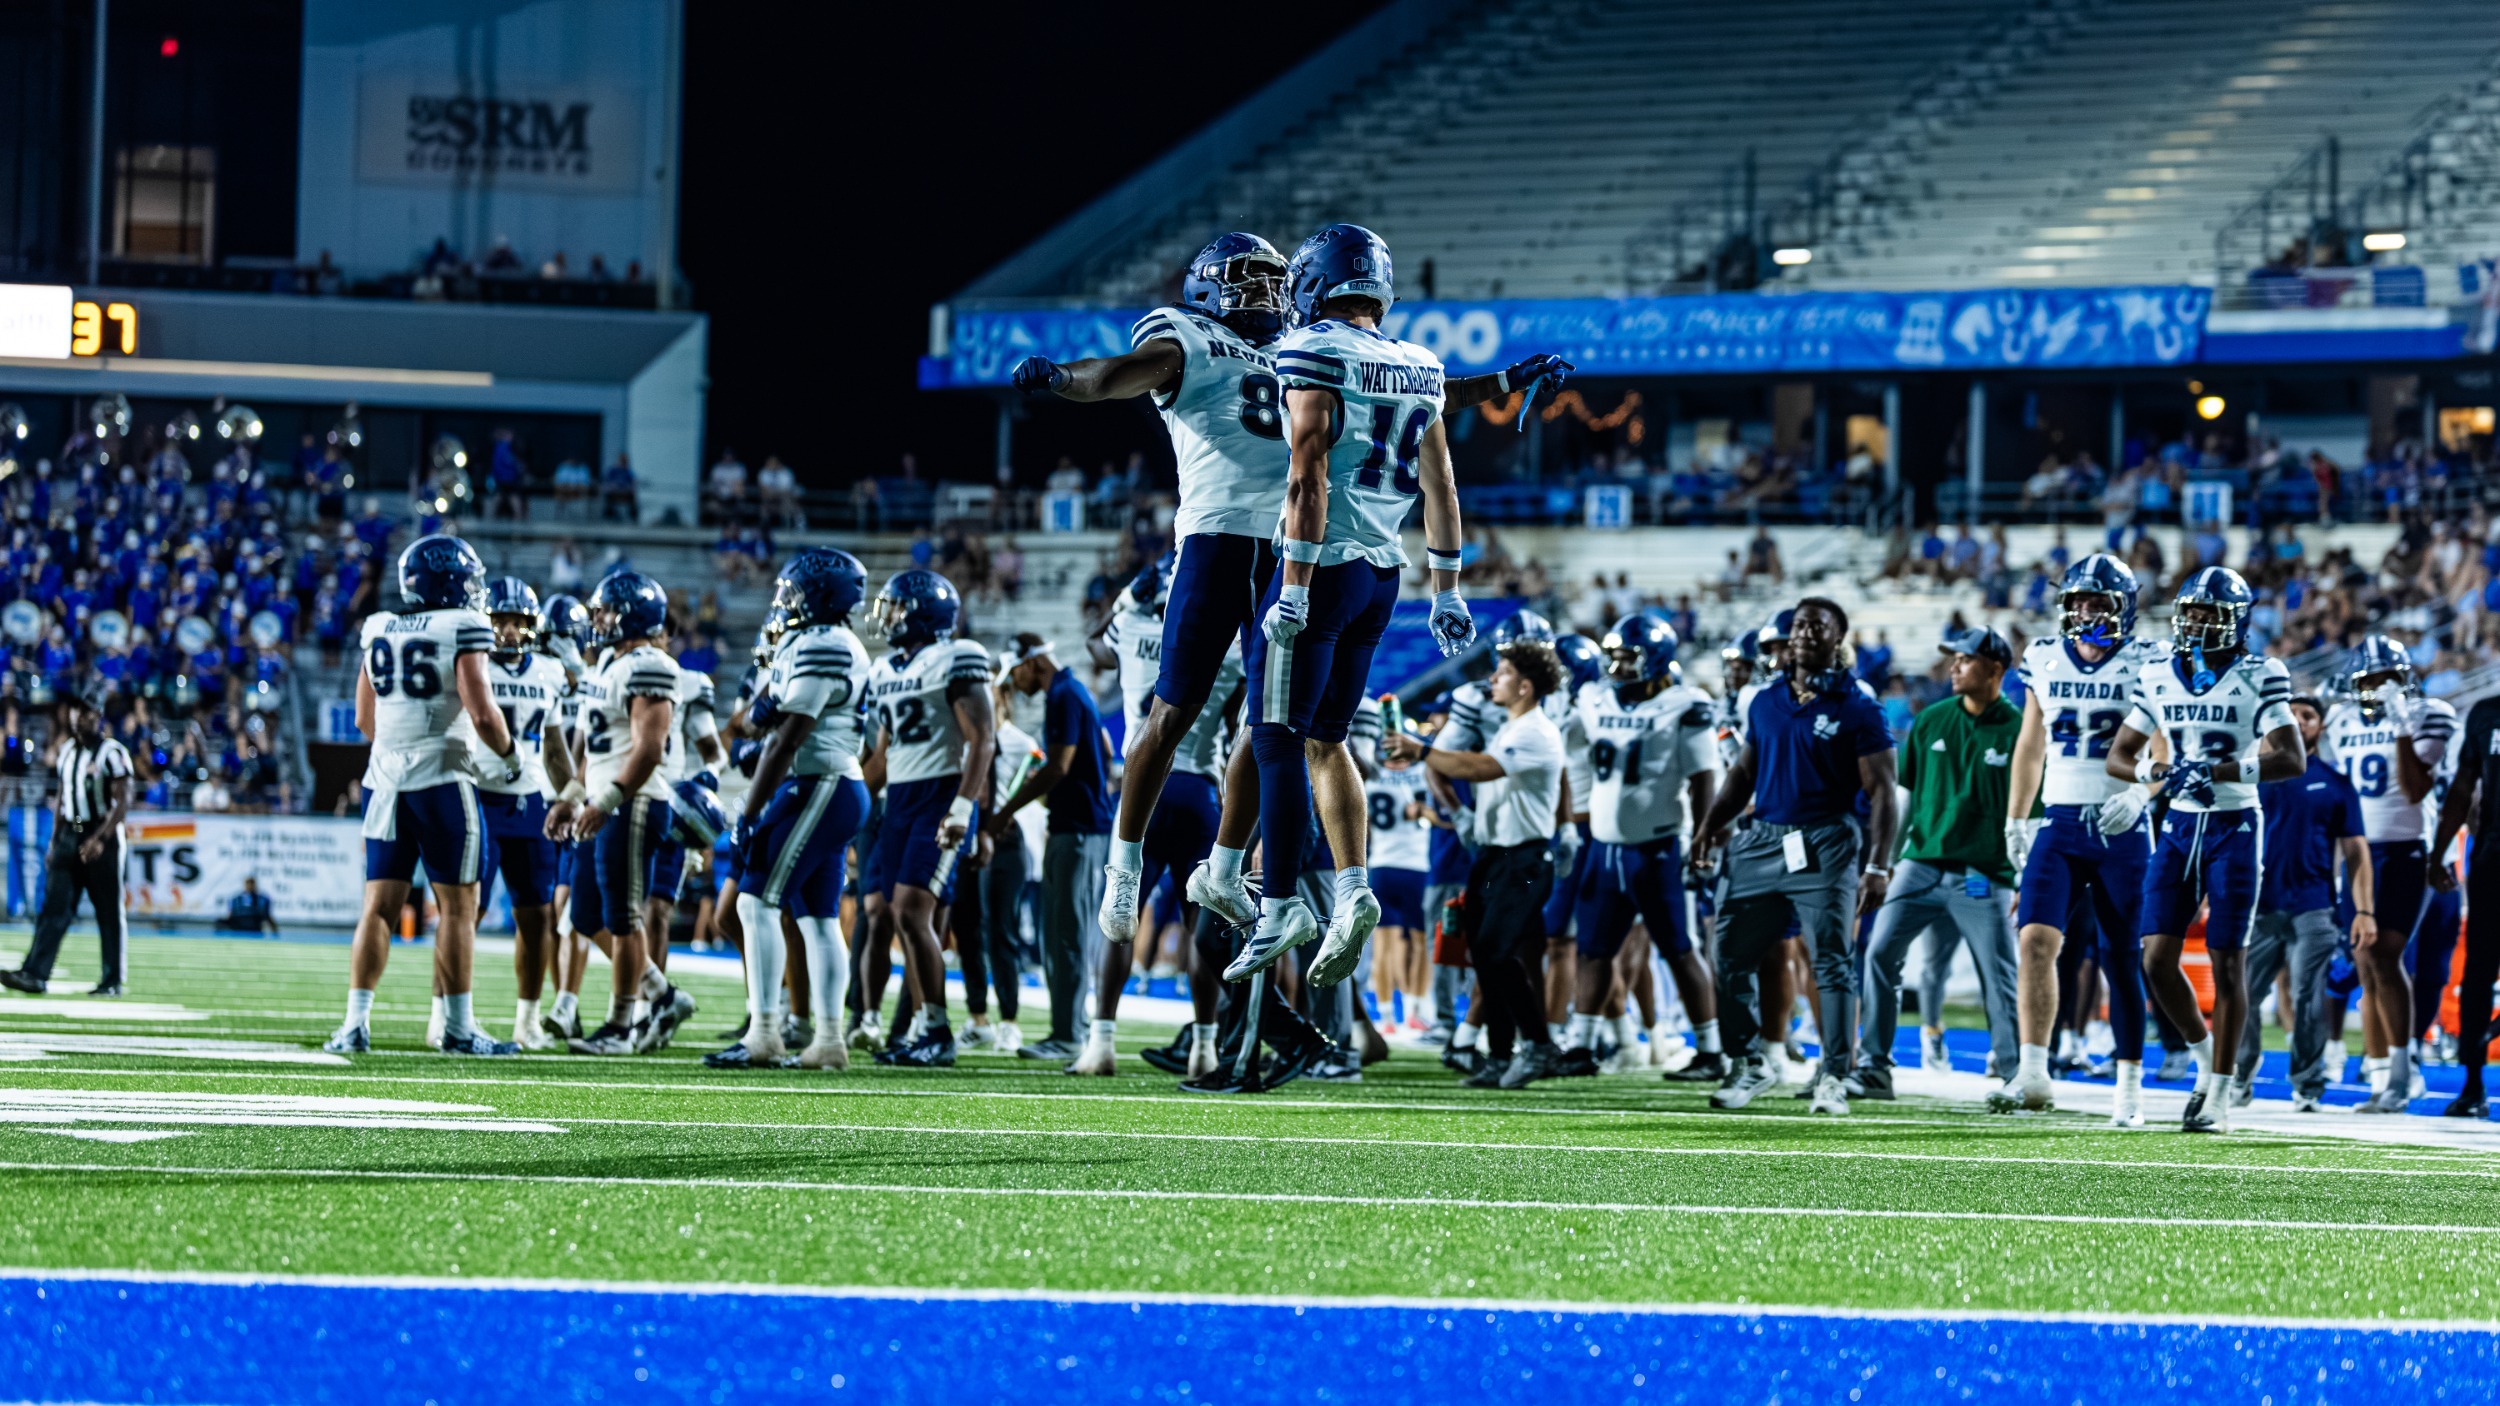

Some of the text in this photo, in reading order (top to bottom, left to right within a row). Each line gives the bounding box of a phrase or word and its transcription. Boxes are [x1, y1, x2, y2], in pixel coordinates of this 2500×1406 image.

[445, 98, 592, 151] SRM
[72, 301, 137, 356] 37
[1359, 361, 1442, 399] WATTENBARGE
[1240, 372, 1284, 440] 8
[371, 637, 442, 699] 96
[2048, 681, 2125, 701] NEVADA
[2051, 708, 2125, 759] 42
[2163, 704, 2239, 723] NEVADA
[124, 845, 201, 885] TS
